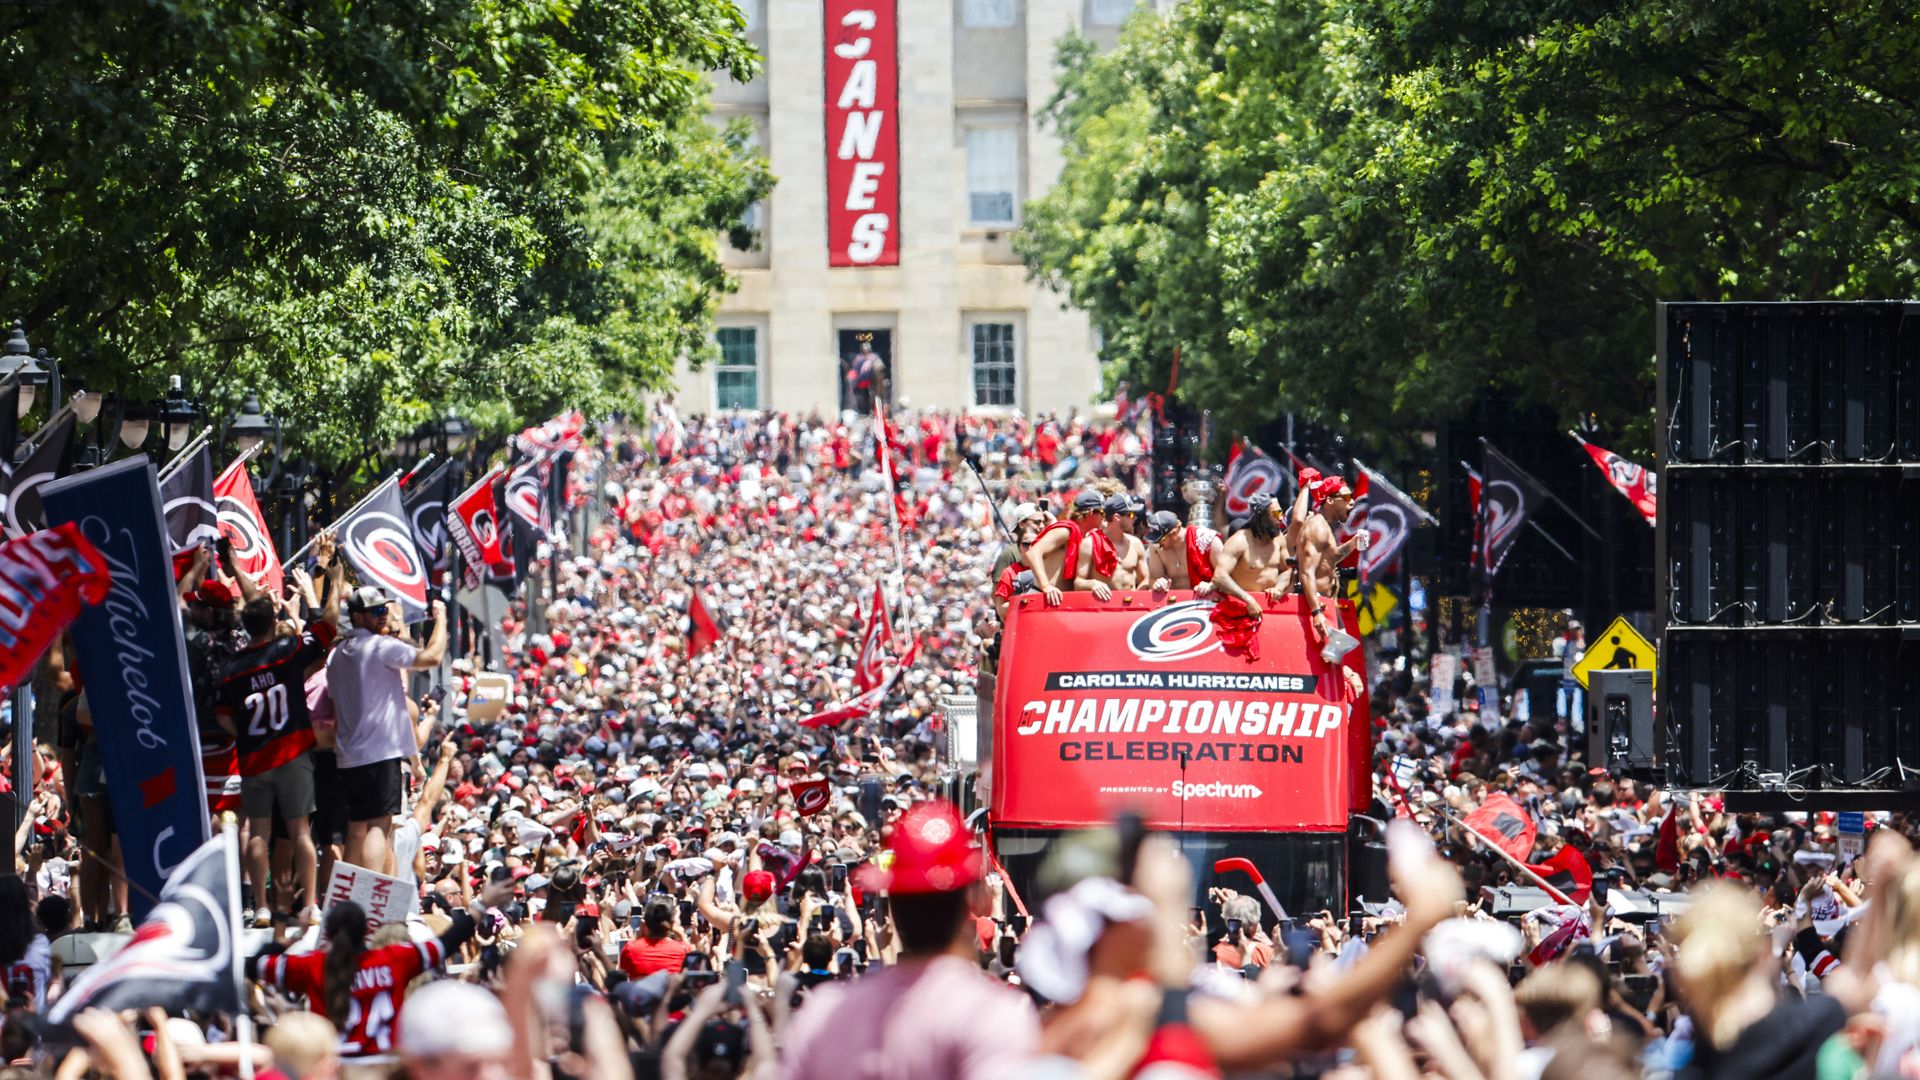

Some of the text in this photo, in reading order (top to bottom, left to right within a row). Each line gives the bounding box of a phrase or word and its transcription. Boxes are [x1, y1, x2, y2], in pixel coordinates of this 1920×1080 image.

[834, 9, 889, 263] CANES
[80, 515, 167, 749] Michelob
[250, 671, 276, 691] AHO
[1059, 673, 1304, 690] CAROLINA HURRICANES
[244, 683, 290, 736] 20
[1017, 698, 1343, 738] CHAMPIONSHIP
[1059, 741, 1304, 764] CELEBRATION
[1171, 780, 1257, 800] Spectrum
[369, 876, 393, 918] NEW
